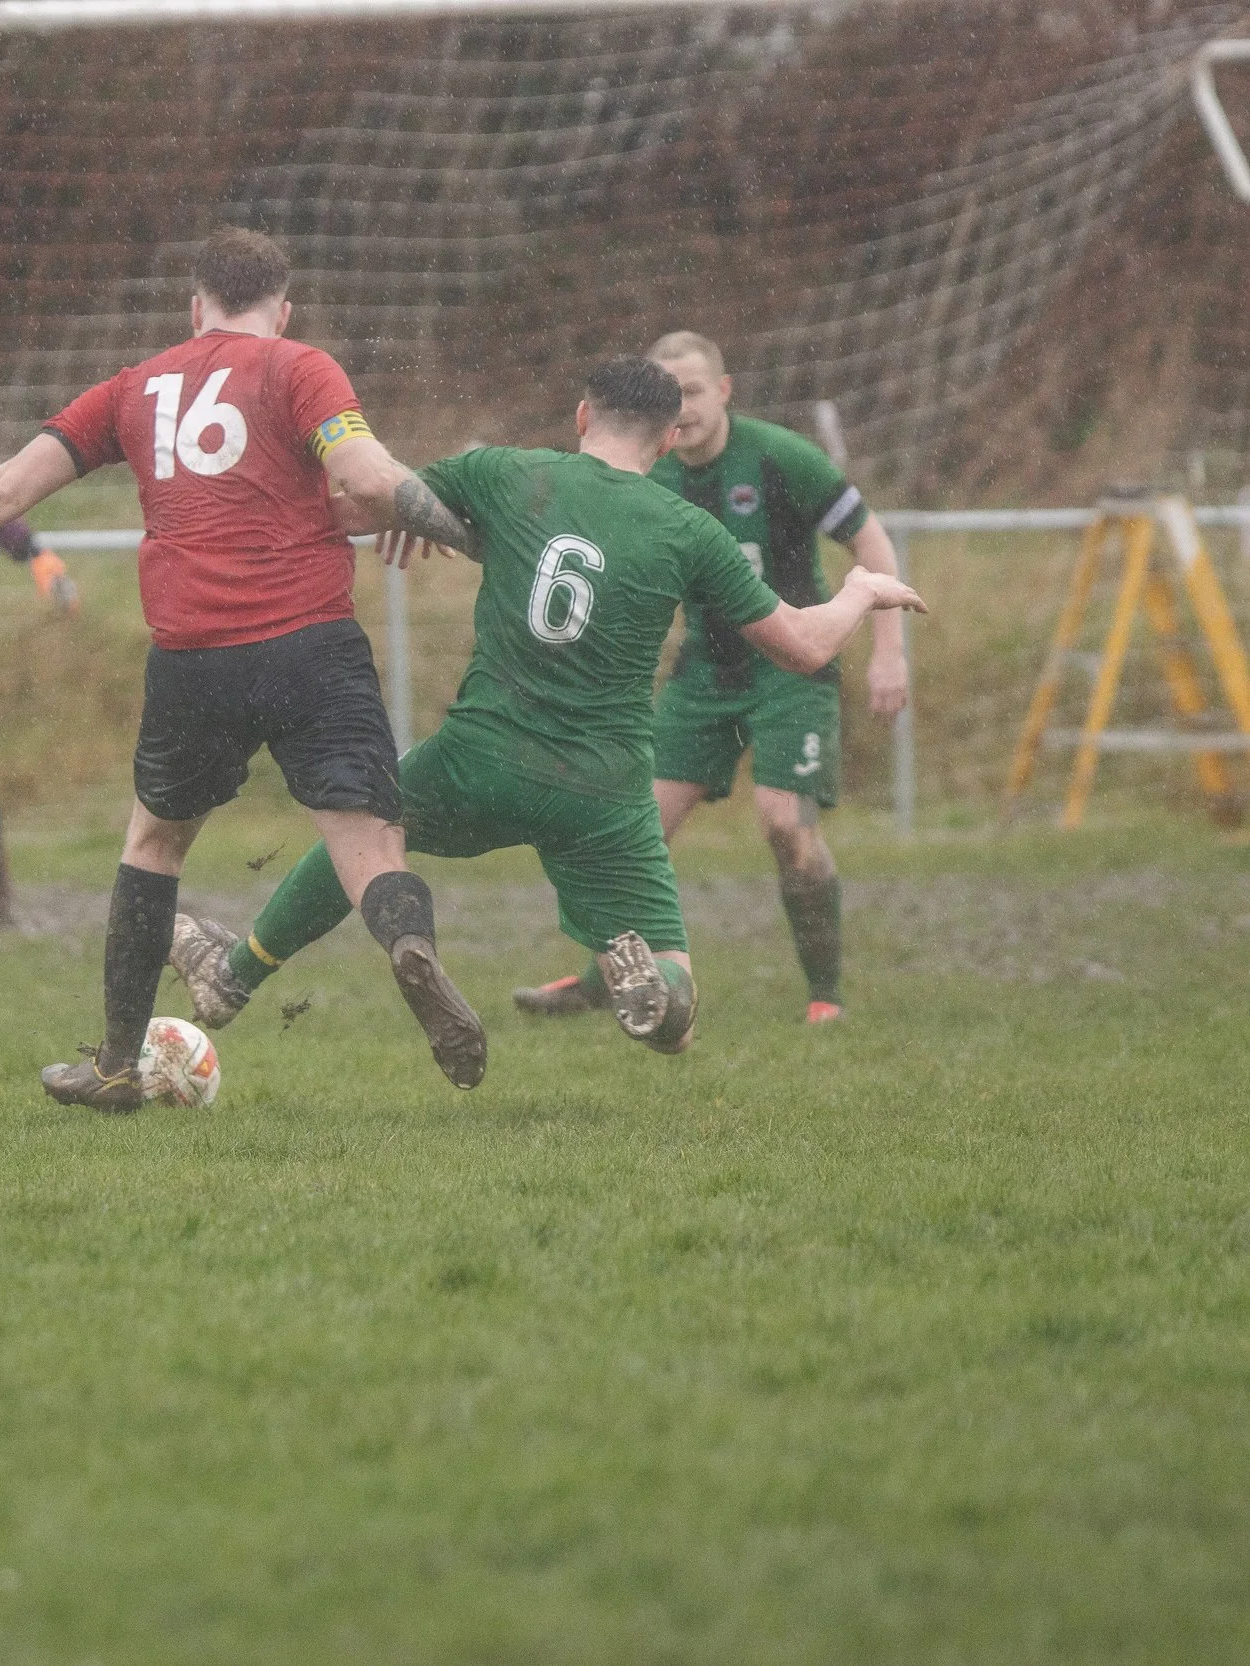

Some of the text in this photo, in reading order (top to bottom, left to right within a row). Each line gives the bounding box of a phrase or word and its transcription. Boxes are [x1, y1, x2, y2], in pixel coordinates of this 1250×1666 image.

[144, 367, 248, 480] 16
[321, 416, 345, 443] C
[528, 534, 605, 643] 6
